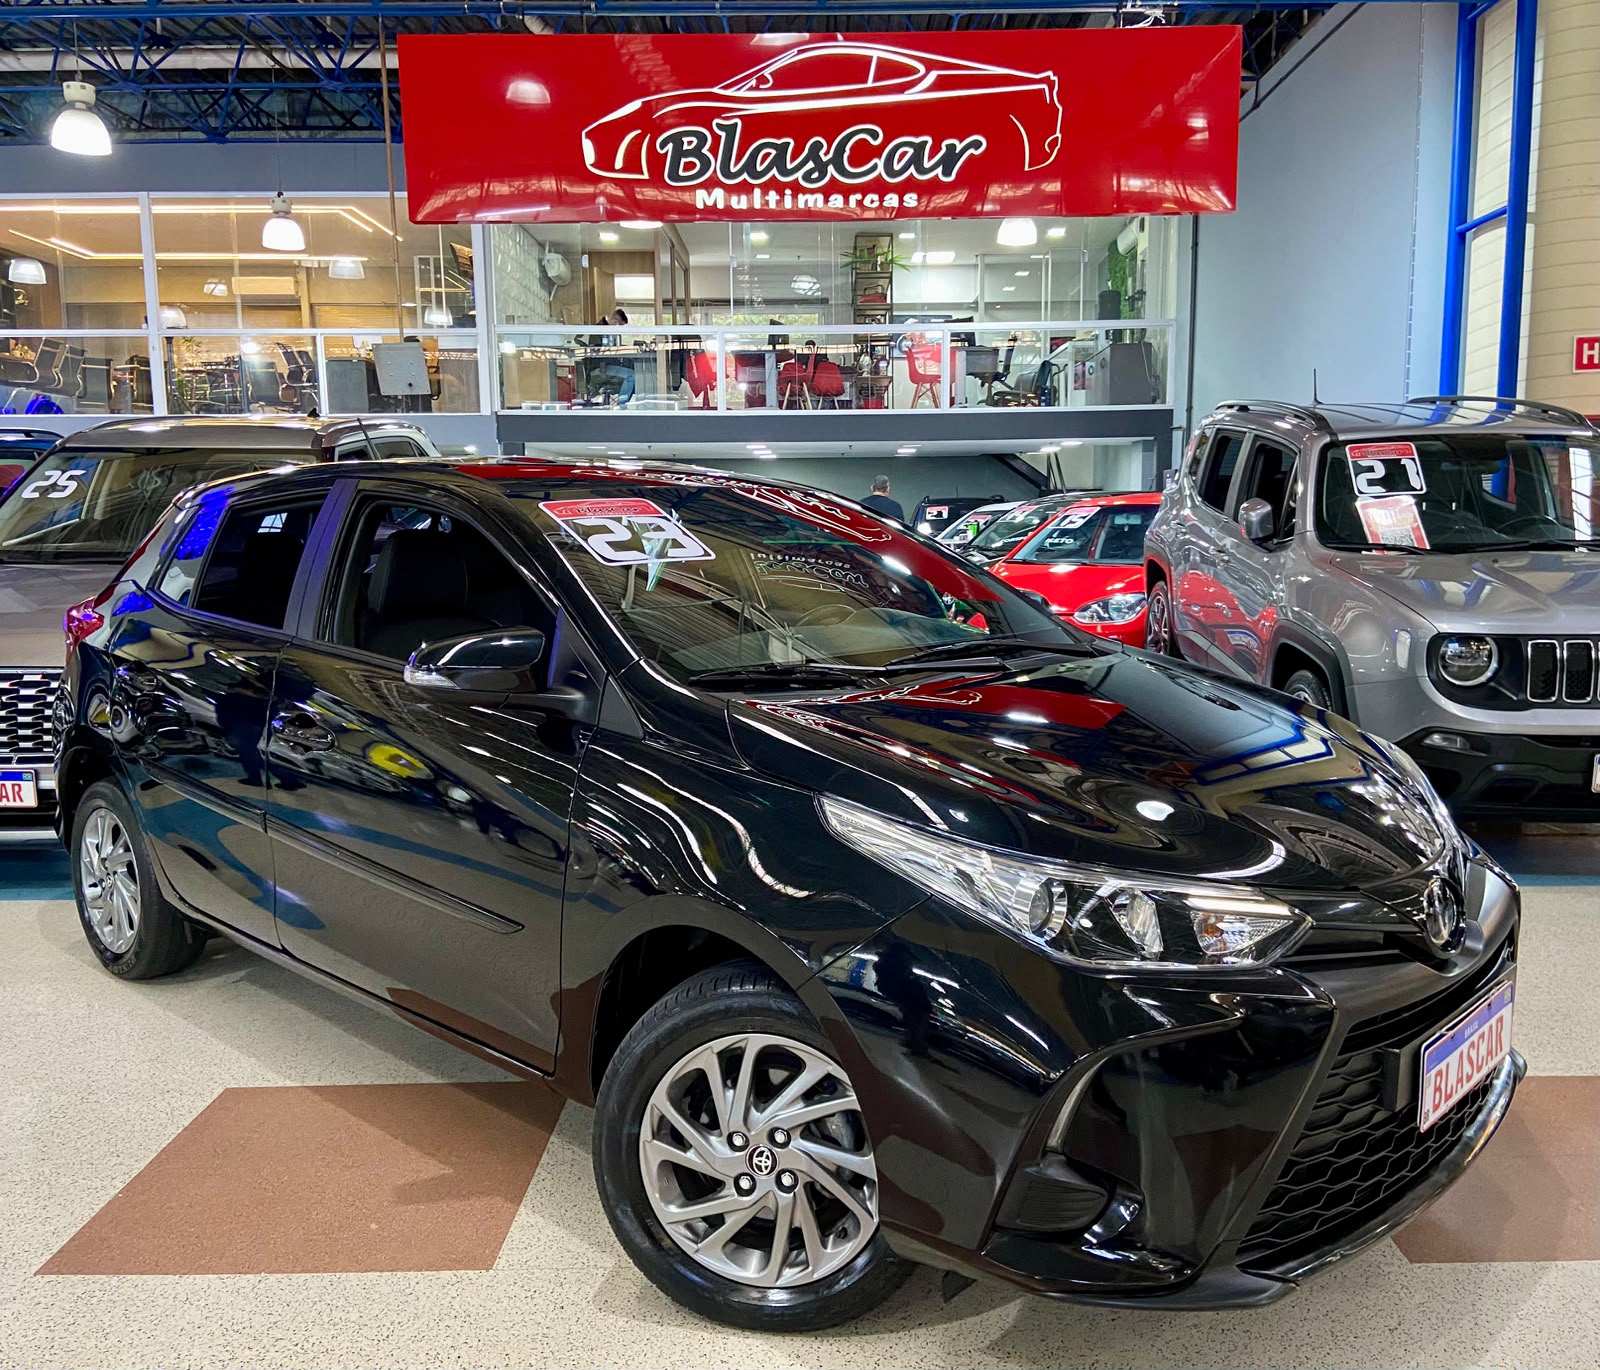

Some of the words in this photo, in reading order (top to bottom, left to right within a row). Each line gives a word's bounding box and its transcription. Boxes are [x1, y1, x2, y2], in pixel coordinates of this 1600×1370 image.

[656, 118, 986, 187] BlasCar
[696, 187, 919, 209] Multimarcas
[21, 470, 87, 499] 25
[572, 516, 704, 561] 23
[1432, 1015, 1504, 1114] BLASCAR
